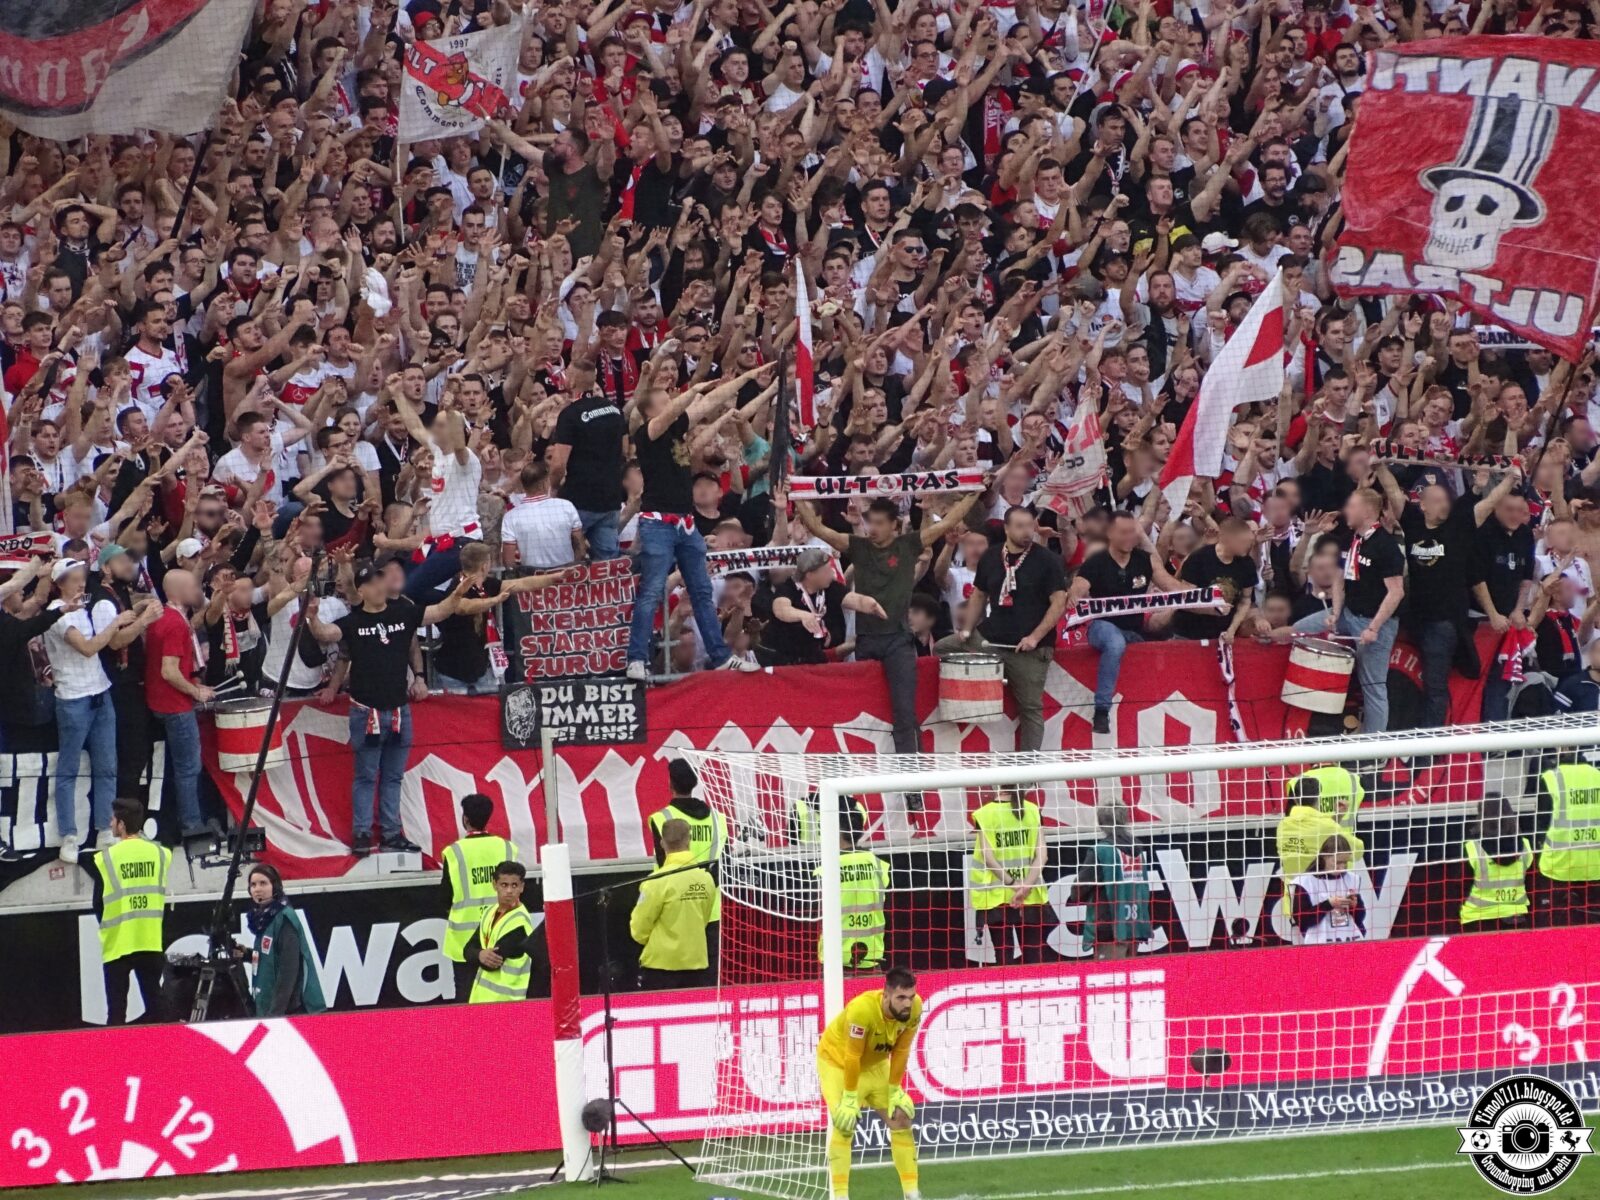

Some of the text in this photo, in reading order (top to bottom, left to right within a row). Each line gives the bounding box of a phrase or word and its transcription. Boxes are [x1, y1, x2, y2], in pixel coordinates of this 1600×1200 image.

[449, 39, 469, 49] 1997
[531, 603, 634, 632] KEHRT
[541, 684, 637, 704] DU BIST
[541, 703, 638, 726] IMMER
[689, 825, 713, 842] URITY
[995, 830, 1030, 848] SECURITY
[120, 861, 155, 880] SECURITY
[471, 866, 497, 885] SECUR
[689, 883, 706, 892] SDS
[1495, 889, 1517, 901] 2012
[129, 895, 148, 909] 1639
[1550, 982, 1585, 1029] 2
[1502, 1022, 1541, 1062] 3
[59, 1086, 96, 1136] 2
[124, 1076, 141, 1123] 1
[1246, 1081, 1488, 1120] Mercedes-Ben
[161, 1095, 214, 1159] 12
[854, 1099, 1218, 1147] Mrcedes-Benz Bank
[11, 1127, 51, 1169] 3
